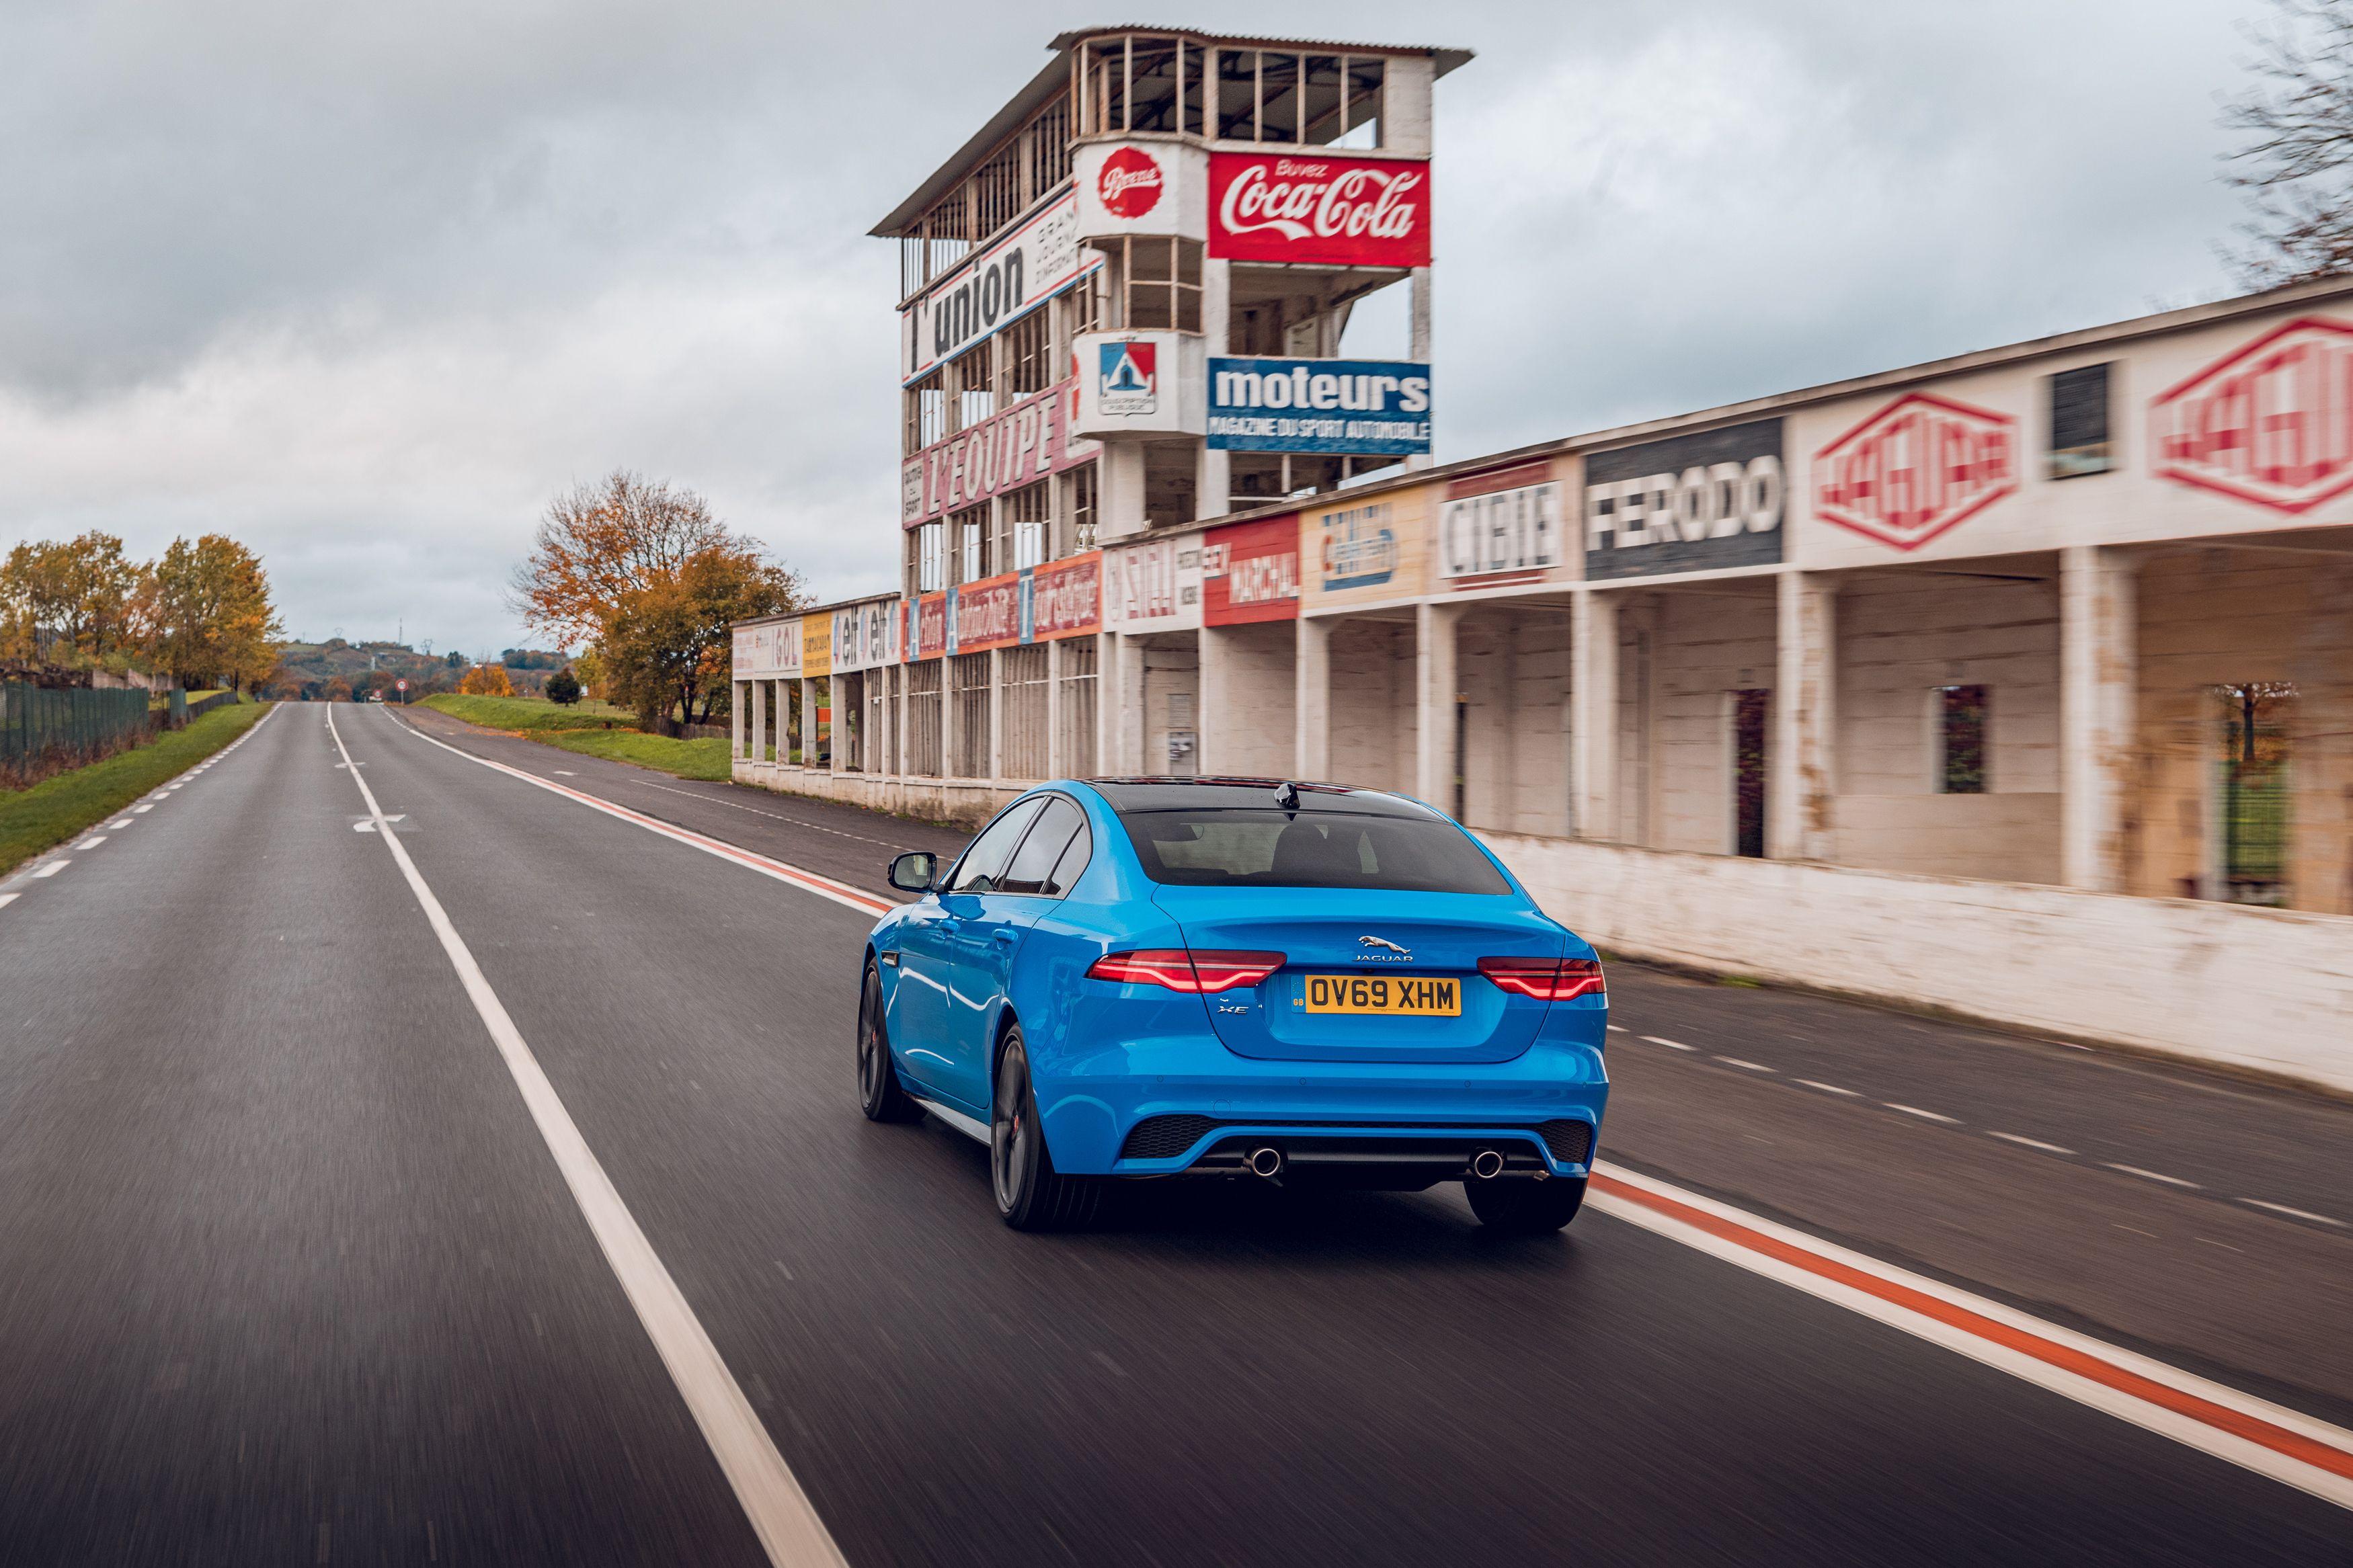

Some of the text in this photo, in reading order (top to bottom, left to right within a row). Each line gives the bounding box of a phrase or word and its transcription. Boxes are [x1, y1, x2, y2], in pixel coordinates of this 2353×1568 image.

[1275, 159, 1328, 178] Buvez
[1220, 165, 1423, 241] Coca-Cola
[1215, 366, 1430, 413] moteurs
[1209, 416, 1430, 440] MAGAZINE DU SPORT AUTOMOBILE
[928, 391, 1058, 515] L'EQUIPE
[1587, 455, 1784, 550] FERODO
[843, 600, 887, 666] elf elf
[1354, 954, 1414, 962] JAGUAR
[1217, 1005, 1249, 1014] XE
[1311, 979, 1453, 1009] OV69 XHM
